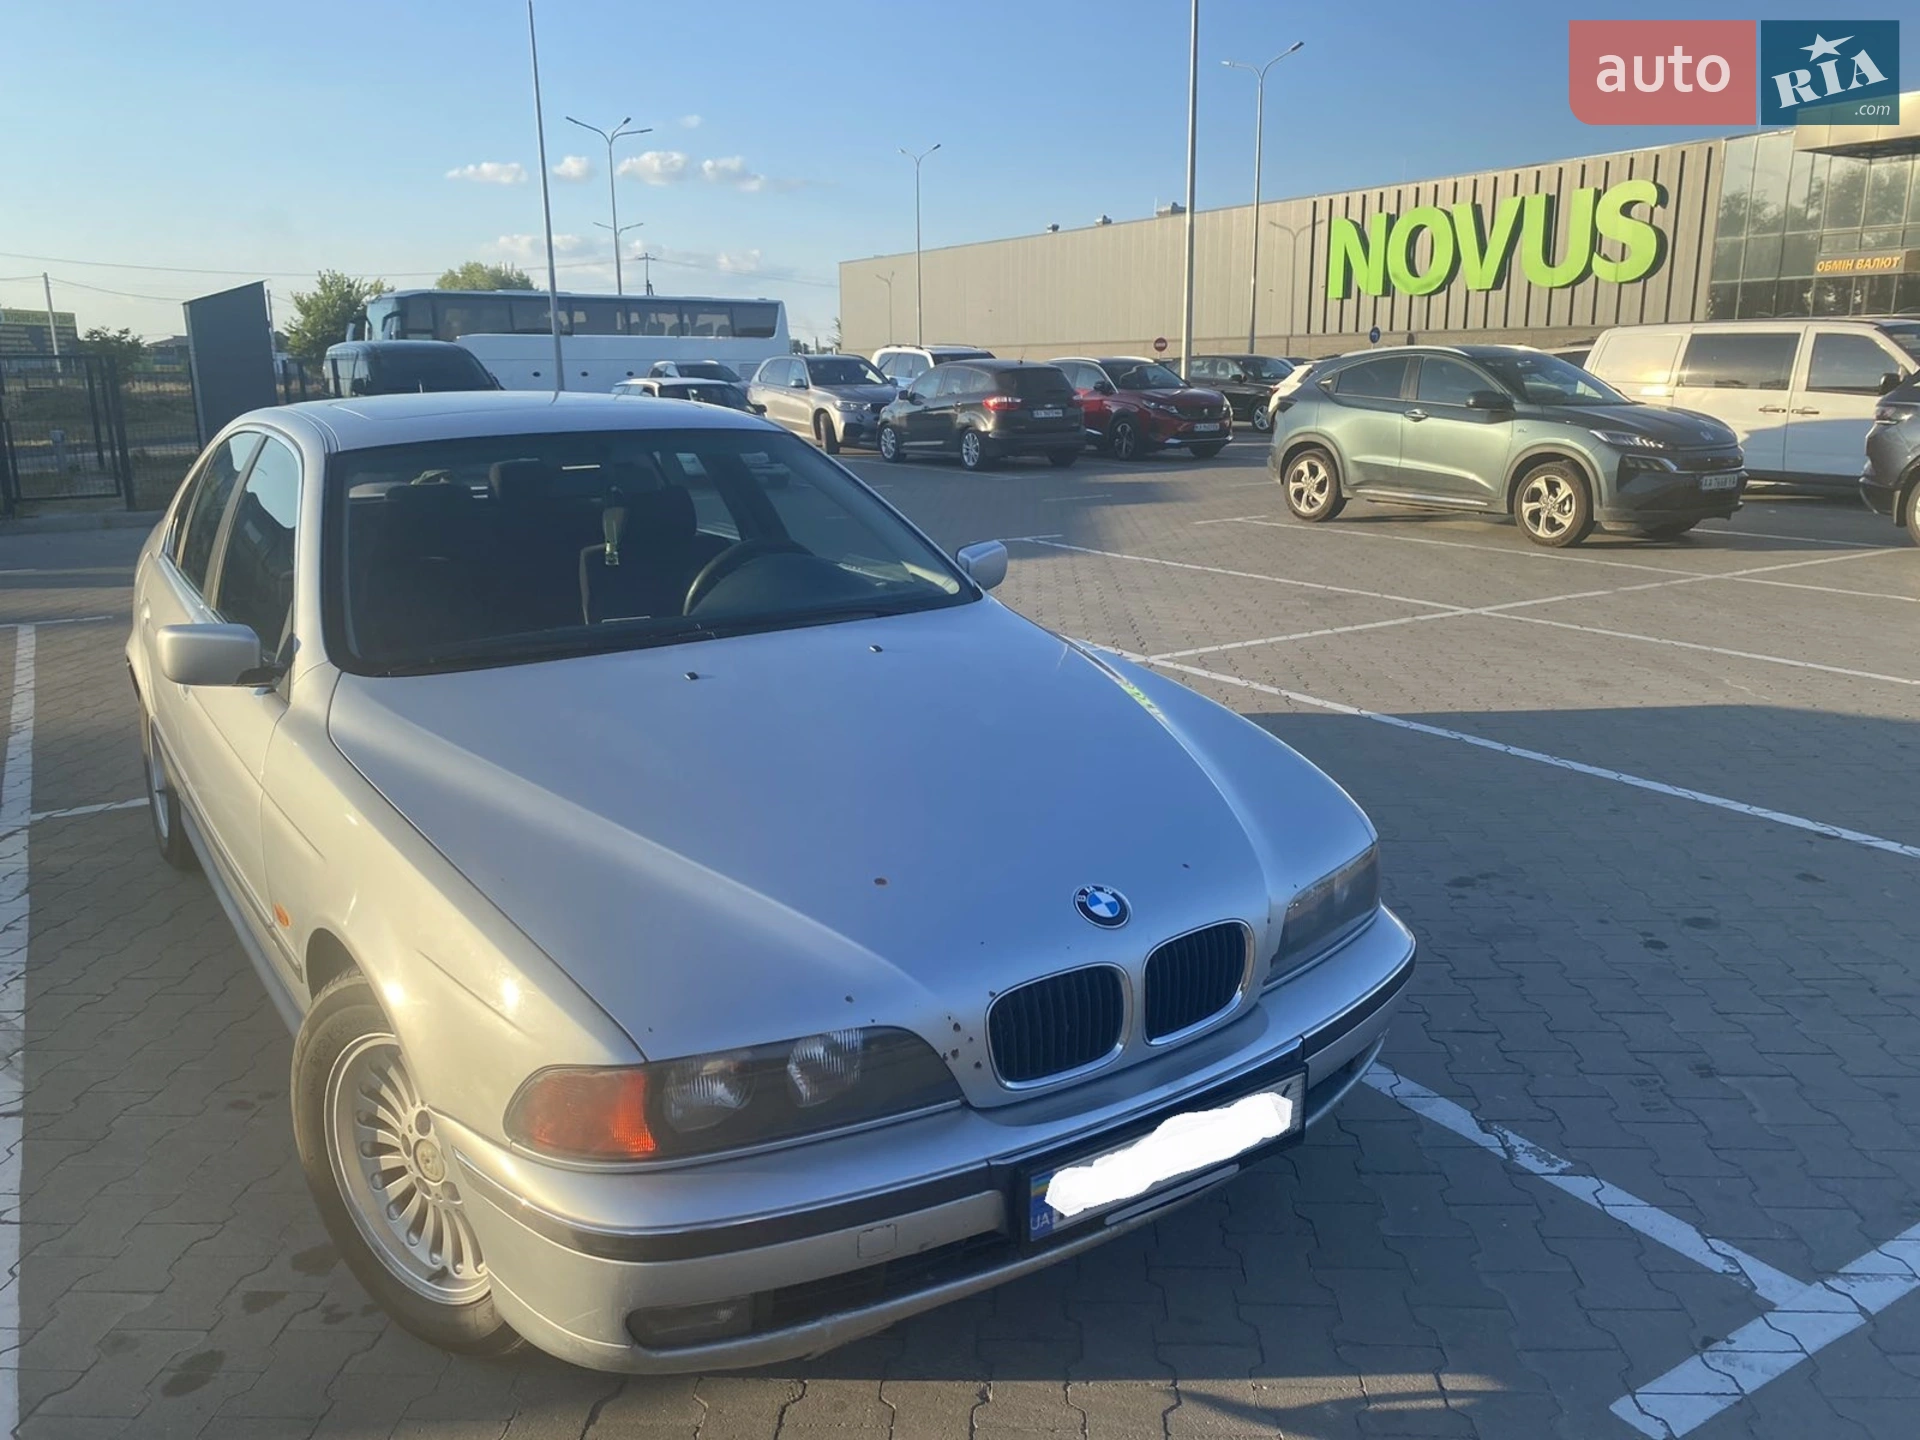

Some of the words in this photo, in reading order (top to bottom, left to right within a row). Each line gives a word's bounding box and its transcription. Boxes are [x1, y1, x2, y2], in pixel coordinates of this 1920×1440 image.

[1327, 179, 1660, 299] NOVUS
[1816, 259, 1855, 273] ОБМІН
[1856, 256, 1902, 270] ВАЛЮТ
[1077, 886, 1114, 902] BMW
[1030, 1212, 1051, 1231] UA
